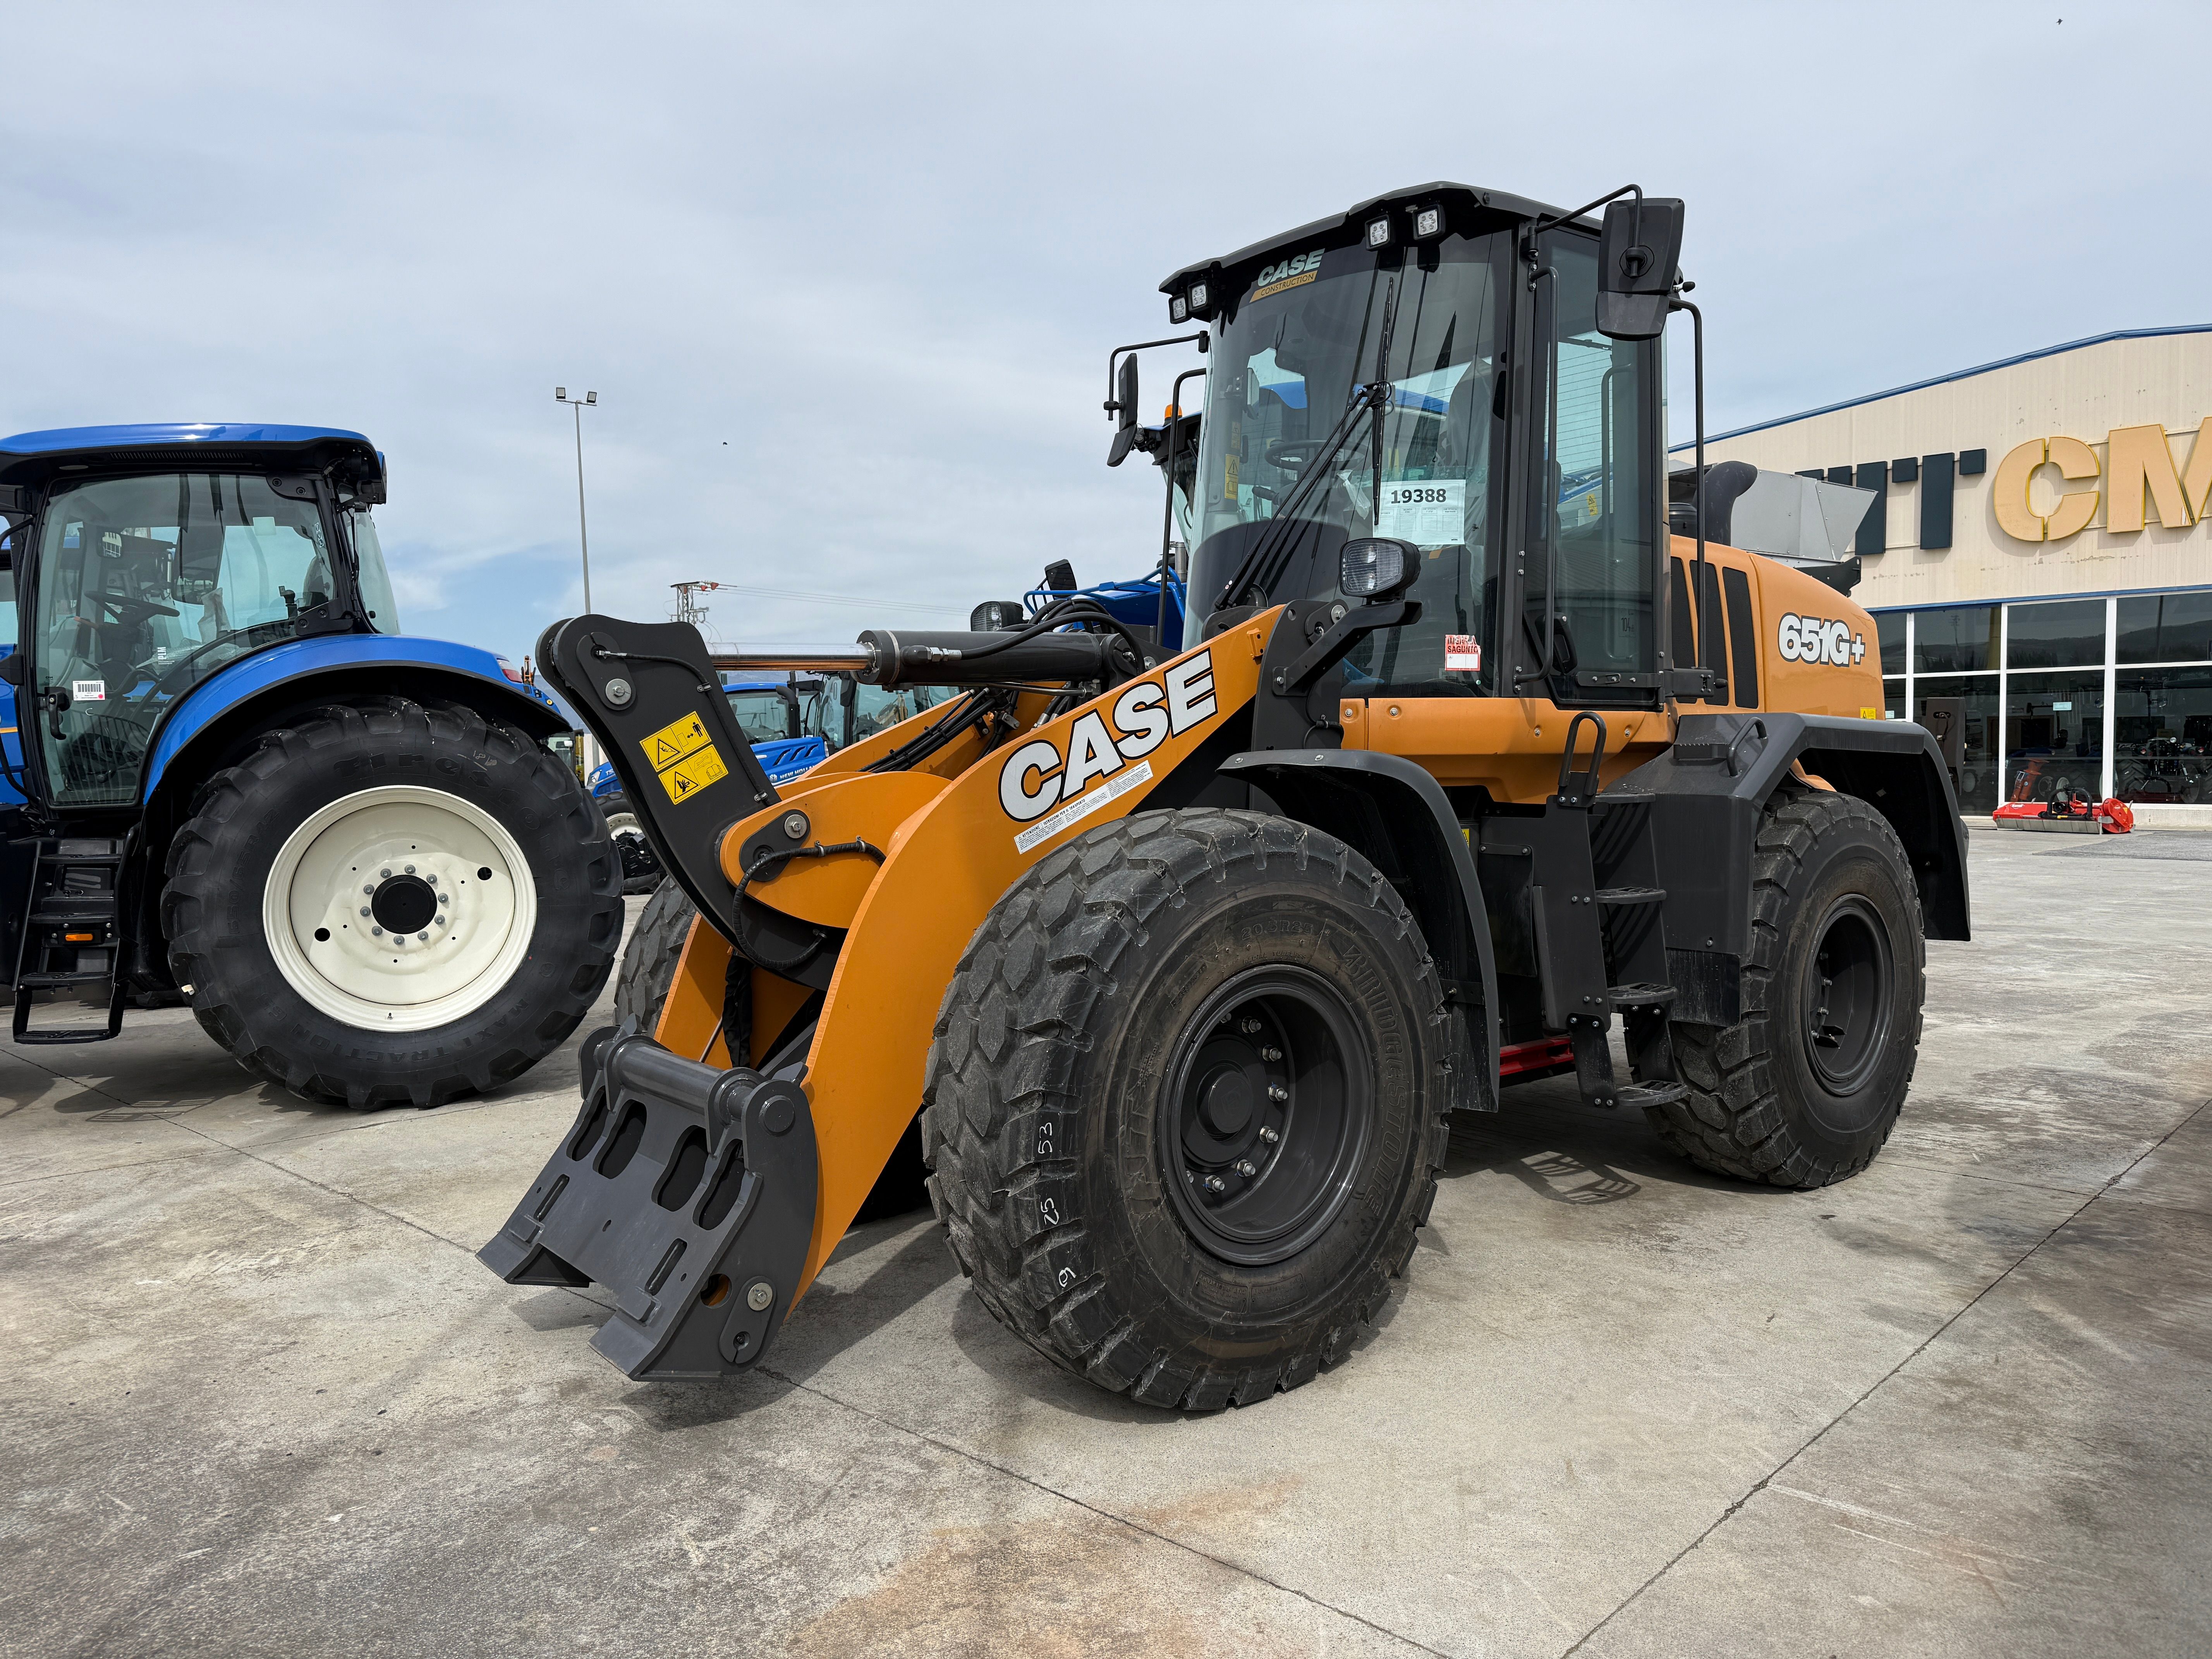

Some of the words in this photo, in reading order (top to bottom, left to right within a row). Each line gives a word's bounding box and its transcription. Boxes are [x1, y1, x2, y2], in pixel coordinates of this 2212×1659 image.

[1258, 248, 1325, 286] CASE
[1261, 273, 1314, 296] CONSTRUCTION
[1391, 489, 1446, 504] 19388
[157, 647, 167, 659] PLM
[1778, 612, 1865, 667] 651G+
[998, 647, 1218, 822] CASE
[1242, 920, 1314, 940] 20.5R25
[1342, 945, 1407, 1216] BRIDGESTONE
[1038, 1122, 1053, 1154] 53
